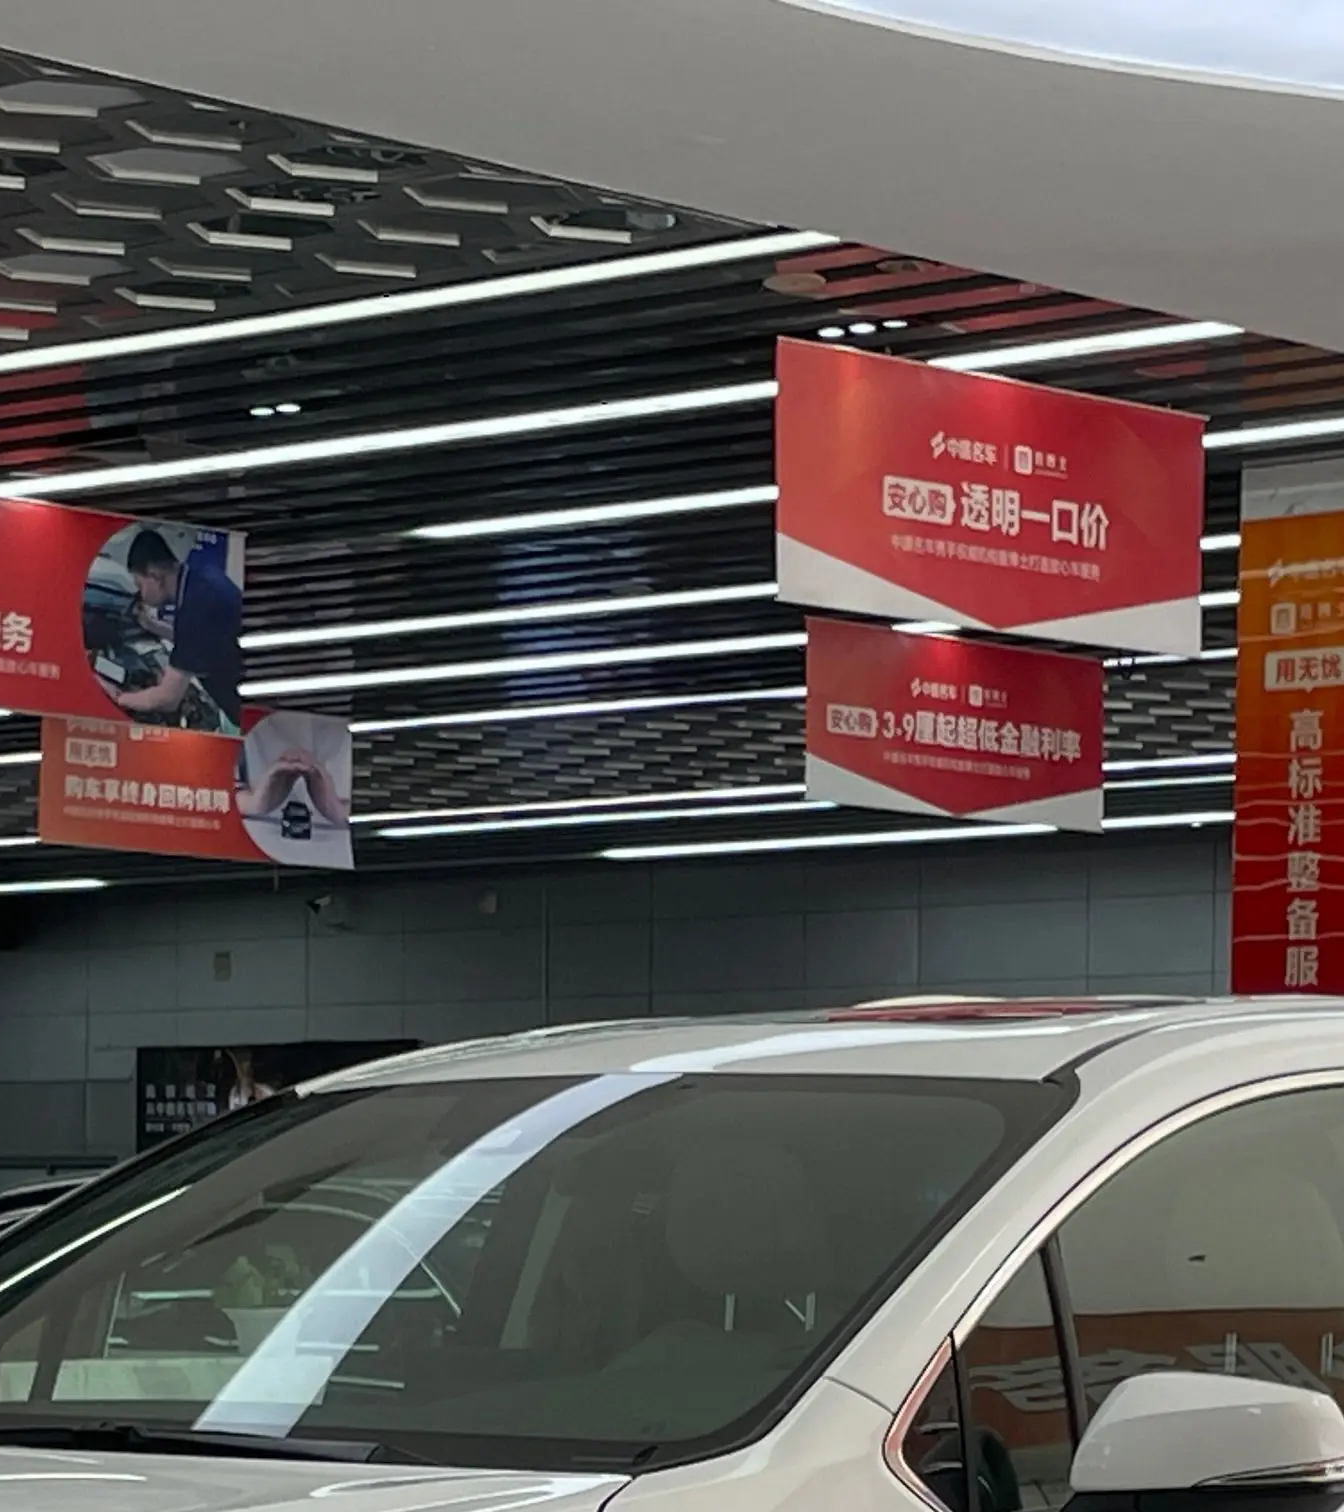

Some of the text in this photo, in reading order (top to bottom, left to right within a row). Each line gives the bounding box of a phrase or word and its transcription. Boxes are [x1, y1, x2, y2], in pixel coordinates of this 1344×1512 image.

[887, 481, 1110, 550] 安心购 透明一口价
[1275, 653, 1343, 684] 用无忧
[882, 709, 1082, 764] 3.9厘起超低金融利率
[1284, 708, 1325, 987] 高标准整备服
